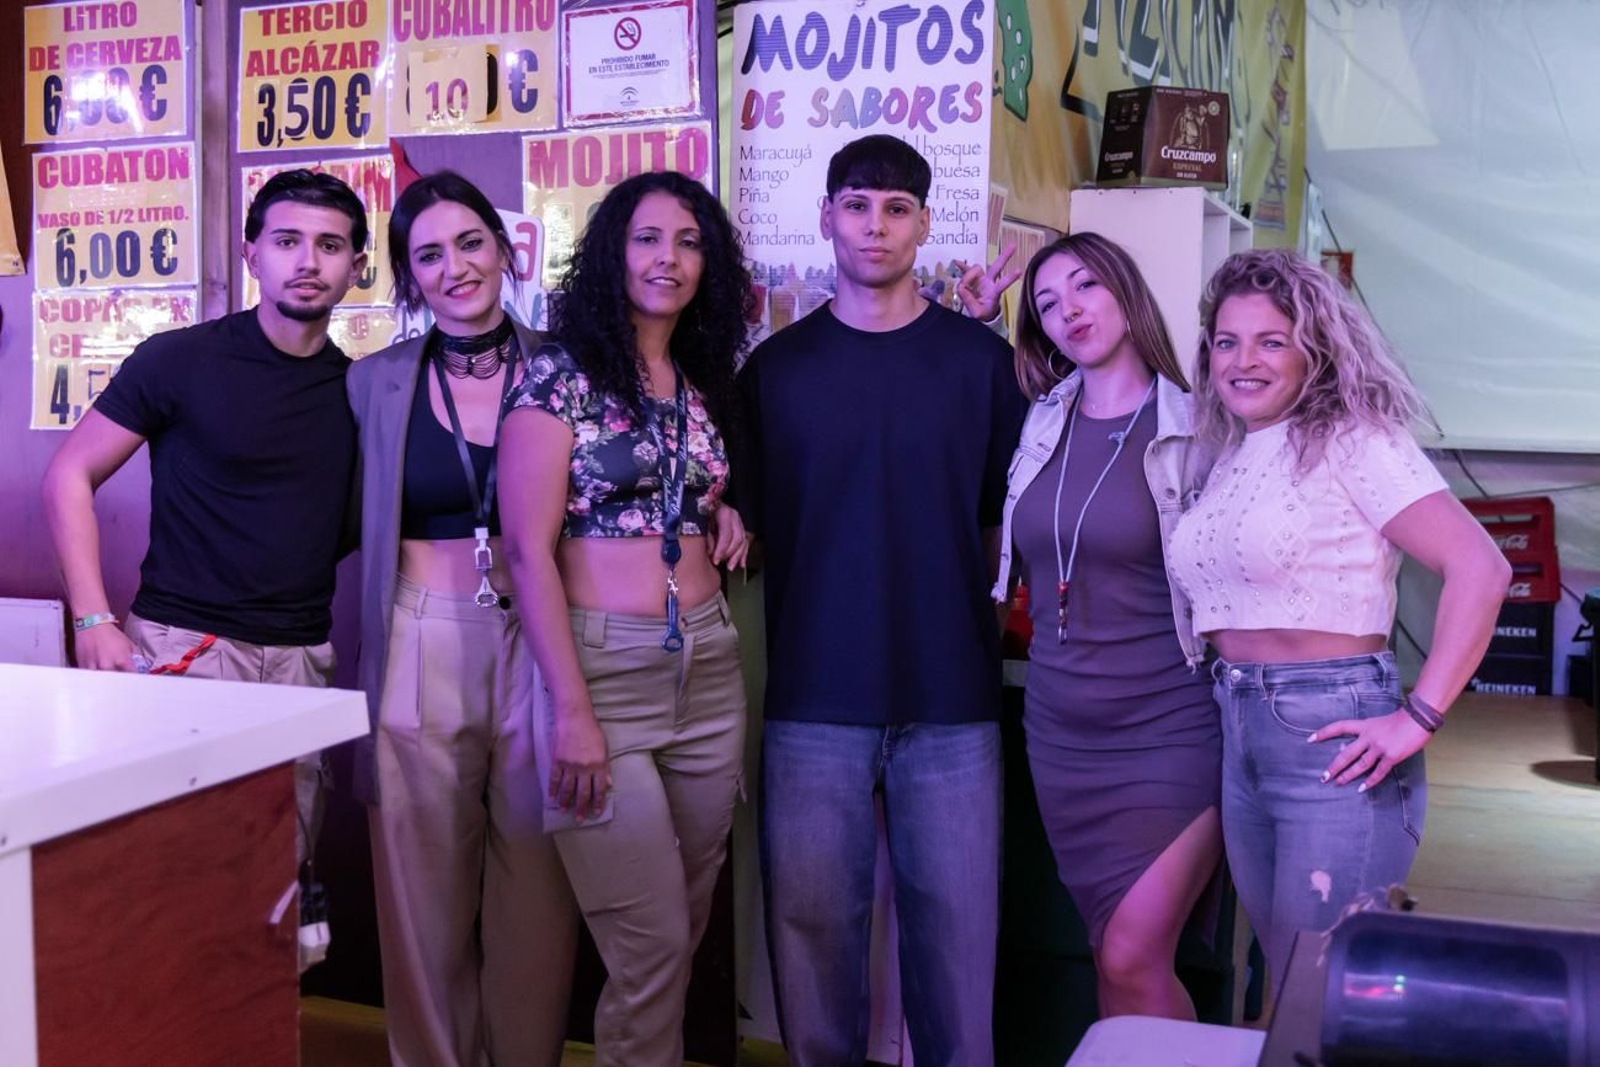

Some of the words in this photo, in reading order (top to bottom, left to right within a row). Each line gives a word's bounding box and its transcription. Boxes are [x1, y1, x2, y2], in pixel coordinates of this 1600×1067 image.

[62, 1, 138, 33] LITRO
[259, 0, 368, 37] TERCIO
[28, 45, 60, 72] DE
[66, 35, 182, 70] CERVEZA
[740, 0, 985, 82] MOJITOS
[245, 40, 380, 77] ALCÁZAR
[588, 64, 598, 73] EN
[598, 63, 613, 73] ESTE
[614, 59, 670, 71] ESTABLECIMIENTO
[601, 55, 634, 65] PROHIBIDO
[635, 52, 657, 62] FUMAR
[139, 64, 168, 121] €
[508, 49, 539, 114] €
[256, 75, 337, 147] 3,50
[344, 73, 371, 138] €
[740, 88, 786, 131] DE
[807, 81, 983, 133] SABORES
[528, 127, 708, 189] MOJITO
[740, 143, 813, 168] Maracuyá
[923, 134, 982, 165] bosque
[1161, 145, 1217, 164] Cruzcampo
[739, 167, 790, 189] Mango
[739, 187, 770, 203] Piña
[37, 211, 81, 229] VASO
[84, 210, 105, 226] DE
[107, 207, 135, 225] 1/2
[138, 206, 190, 223] LITRO.
[738, 208, 778, 225] Coco
[931, 201, 979, 223] Melón
[738, 224, 815, 246] Mandarina
[55, 228, 141, 288] 6,00
[149, 228, 178, 277] €
[1494, 626, 1537, 638] NEKEN
[1476, 682, 1537, 696] HEINEKEN
